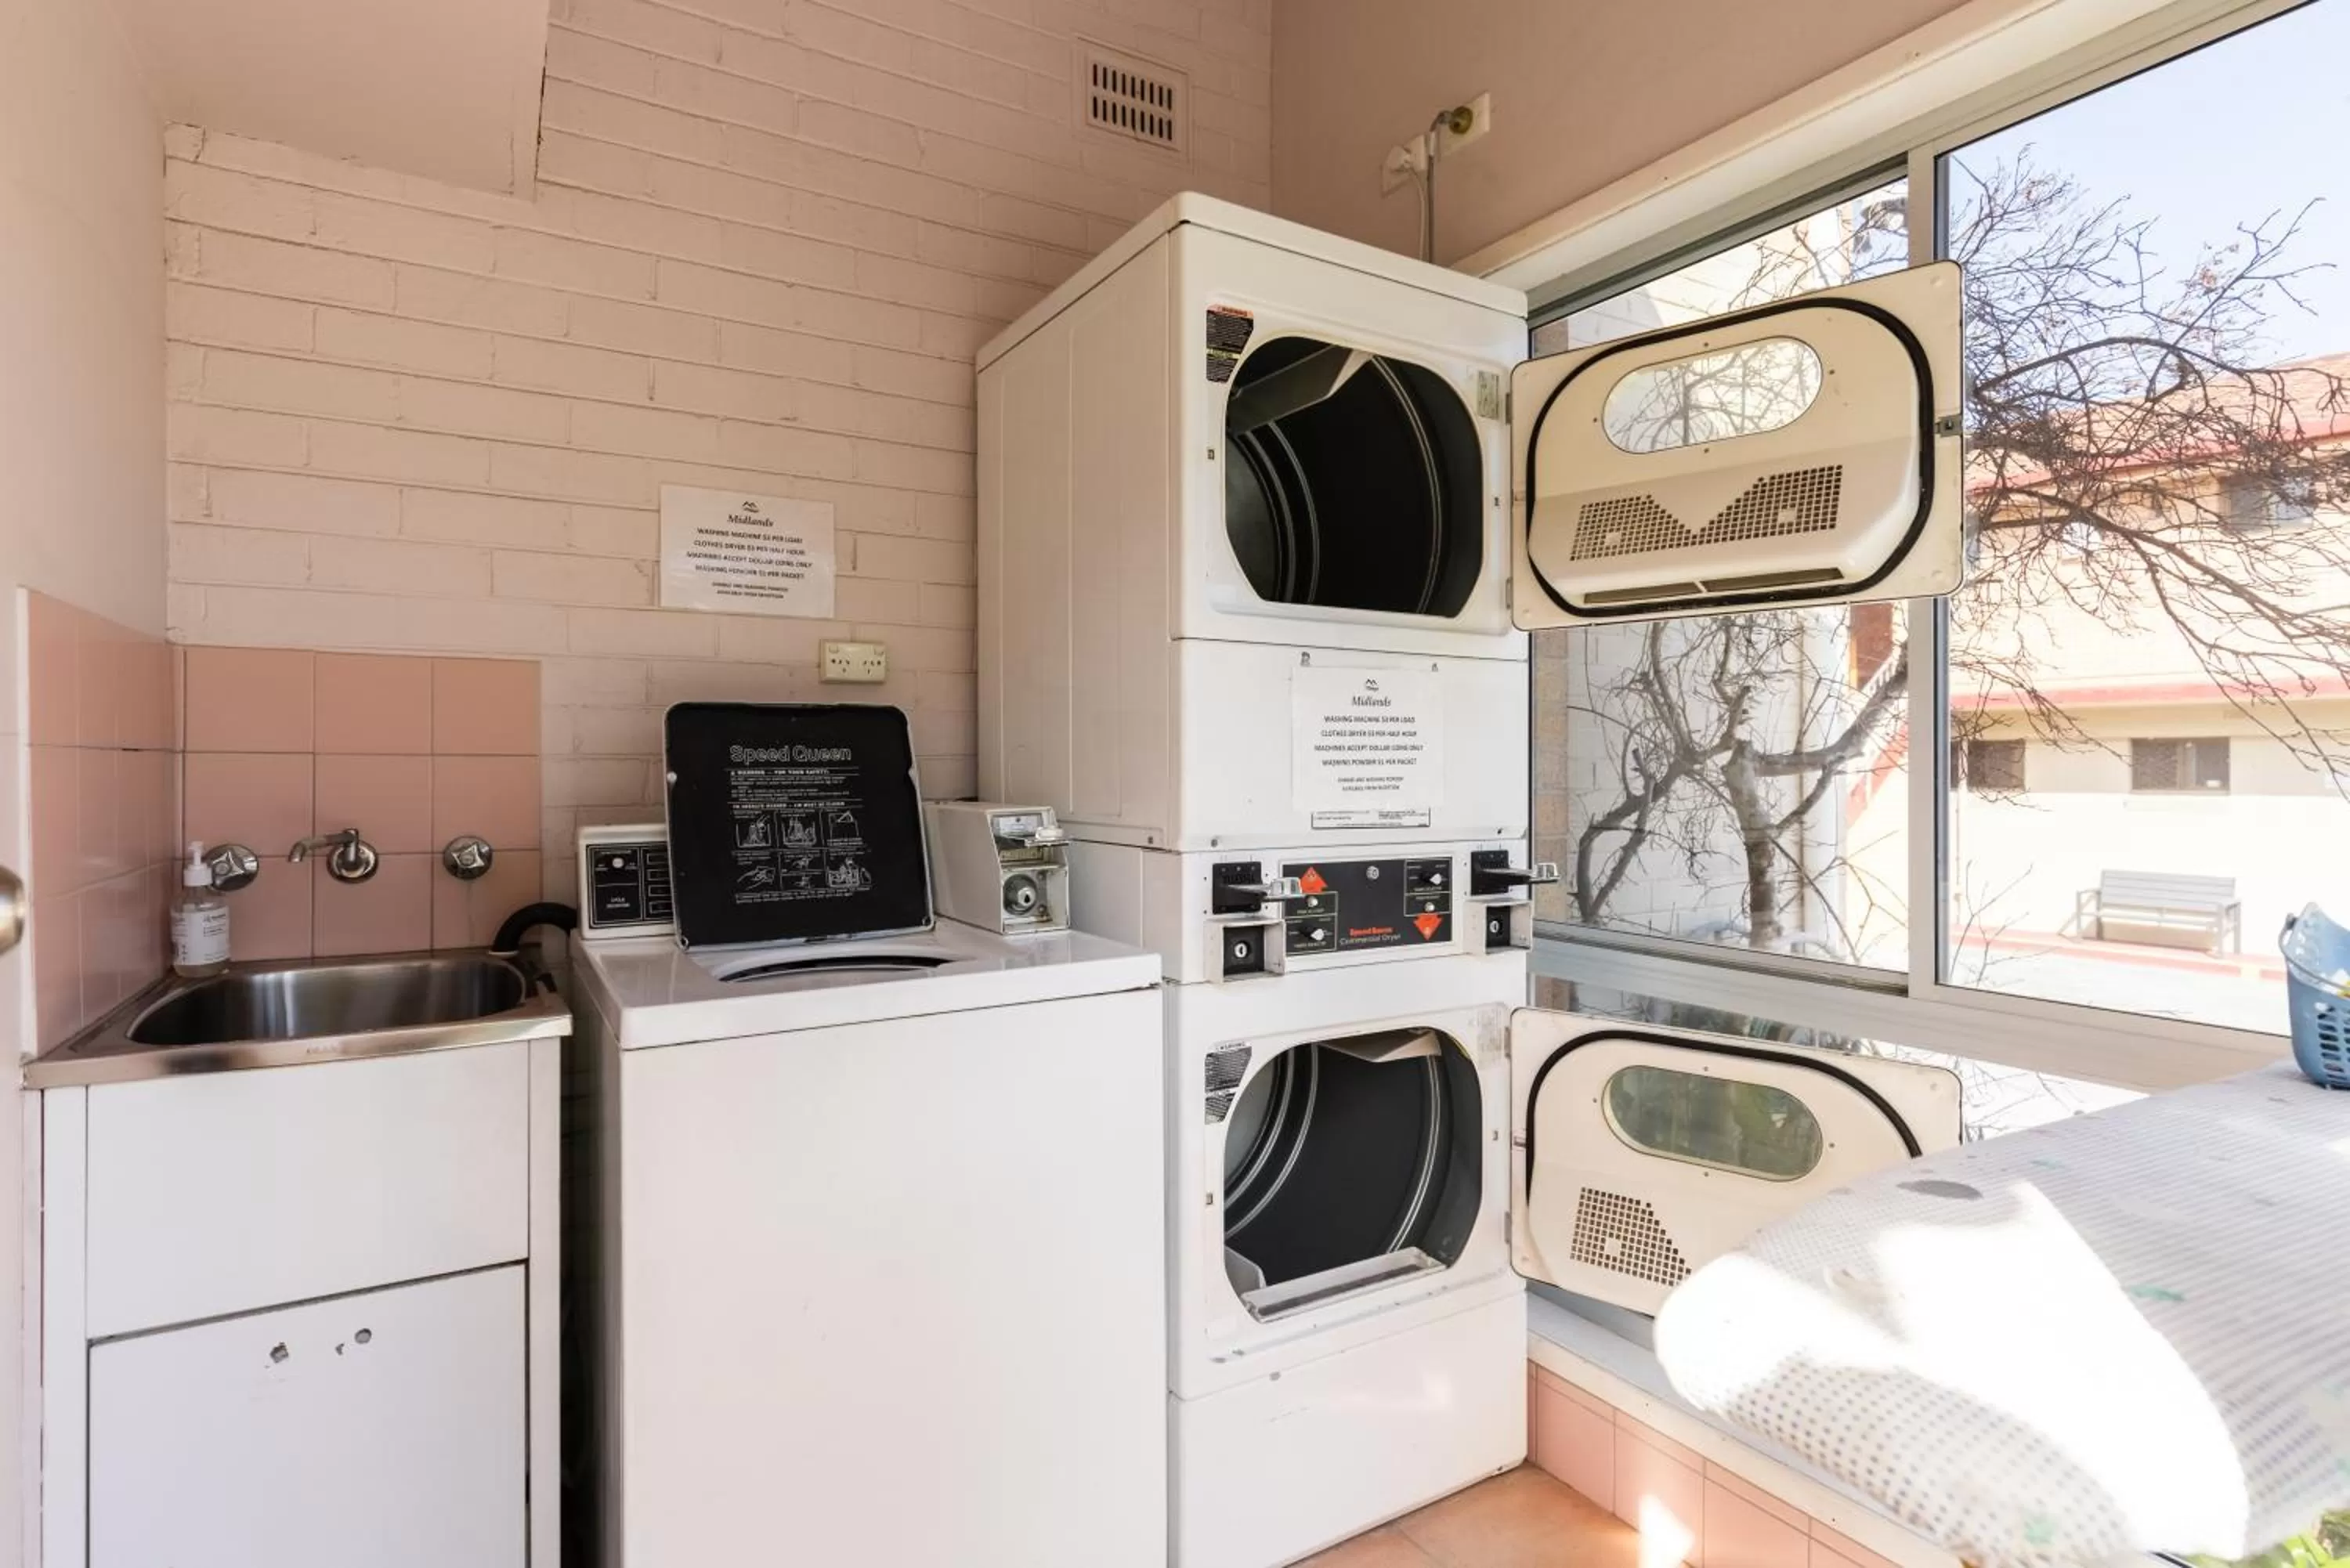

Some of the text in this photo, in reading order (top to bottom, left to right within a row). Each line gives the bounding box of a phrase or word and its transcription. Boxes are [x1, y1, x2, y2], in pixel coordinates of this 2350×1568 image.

[727, 514, 774, 527] Midlands
[697, 527, 729, 537] WASHING
[731, 531, 761, 540] MACHINE
[1353, 695, 1391, 707] Midlands
[730, 745, 851, 765] Speed Queen
